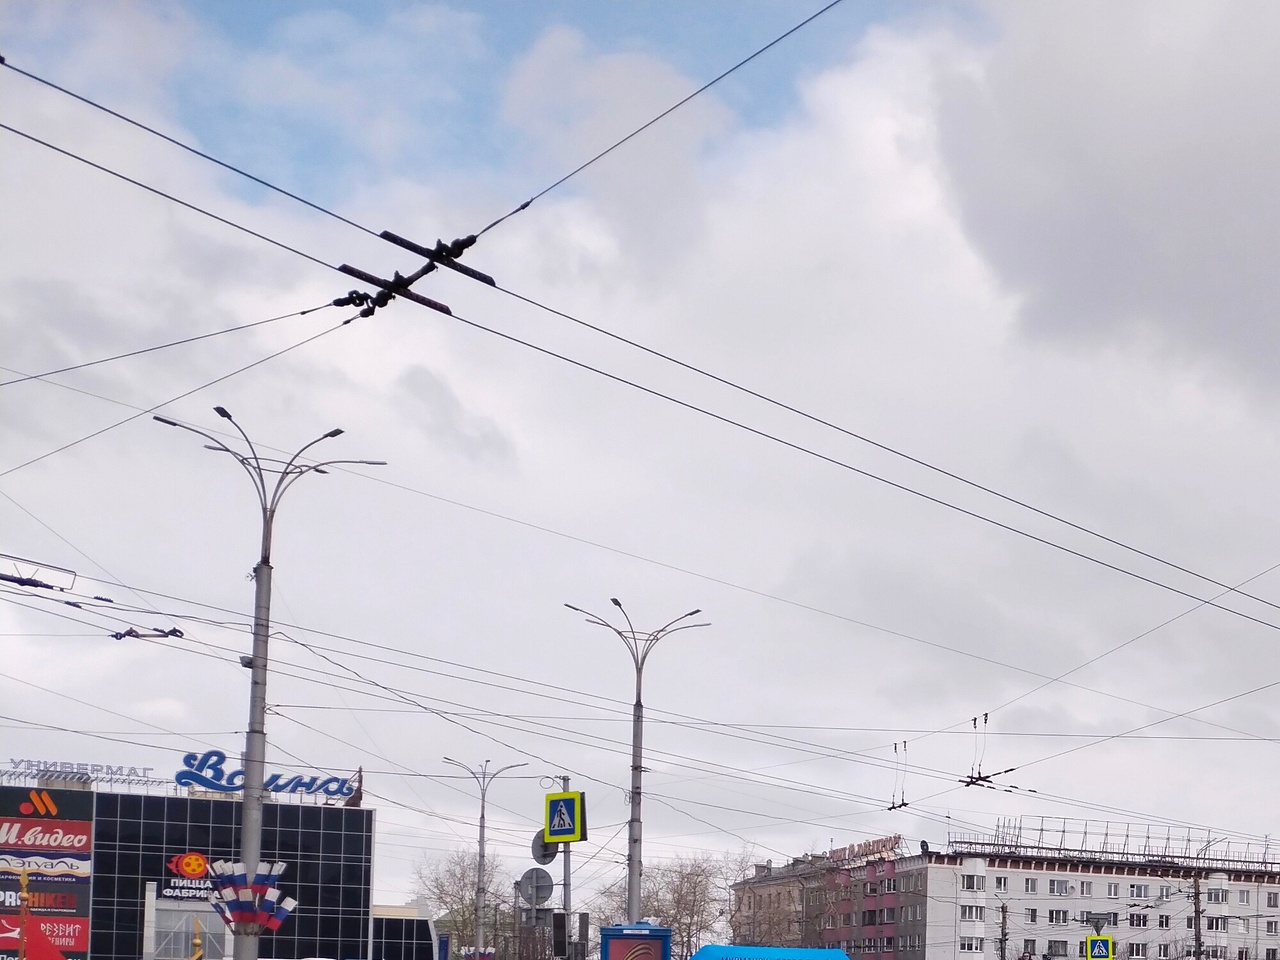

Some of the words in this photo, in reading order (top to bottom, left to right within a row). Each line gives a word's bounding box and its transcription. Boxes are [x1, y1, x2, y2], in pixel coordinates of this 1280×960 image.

[10, 758, 154, 777] УНИВЕРМАГ
[0, 822, 88, 848] М.видео
[170, 878, 212, 888] ПИЦЦА
